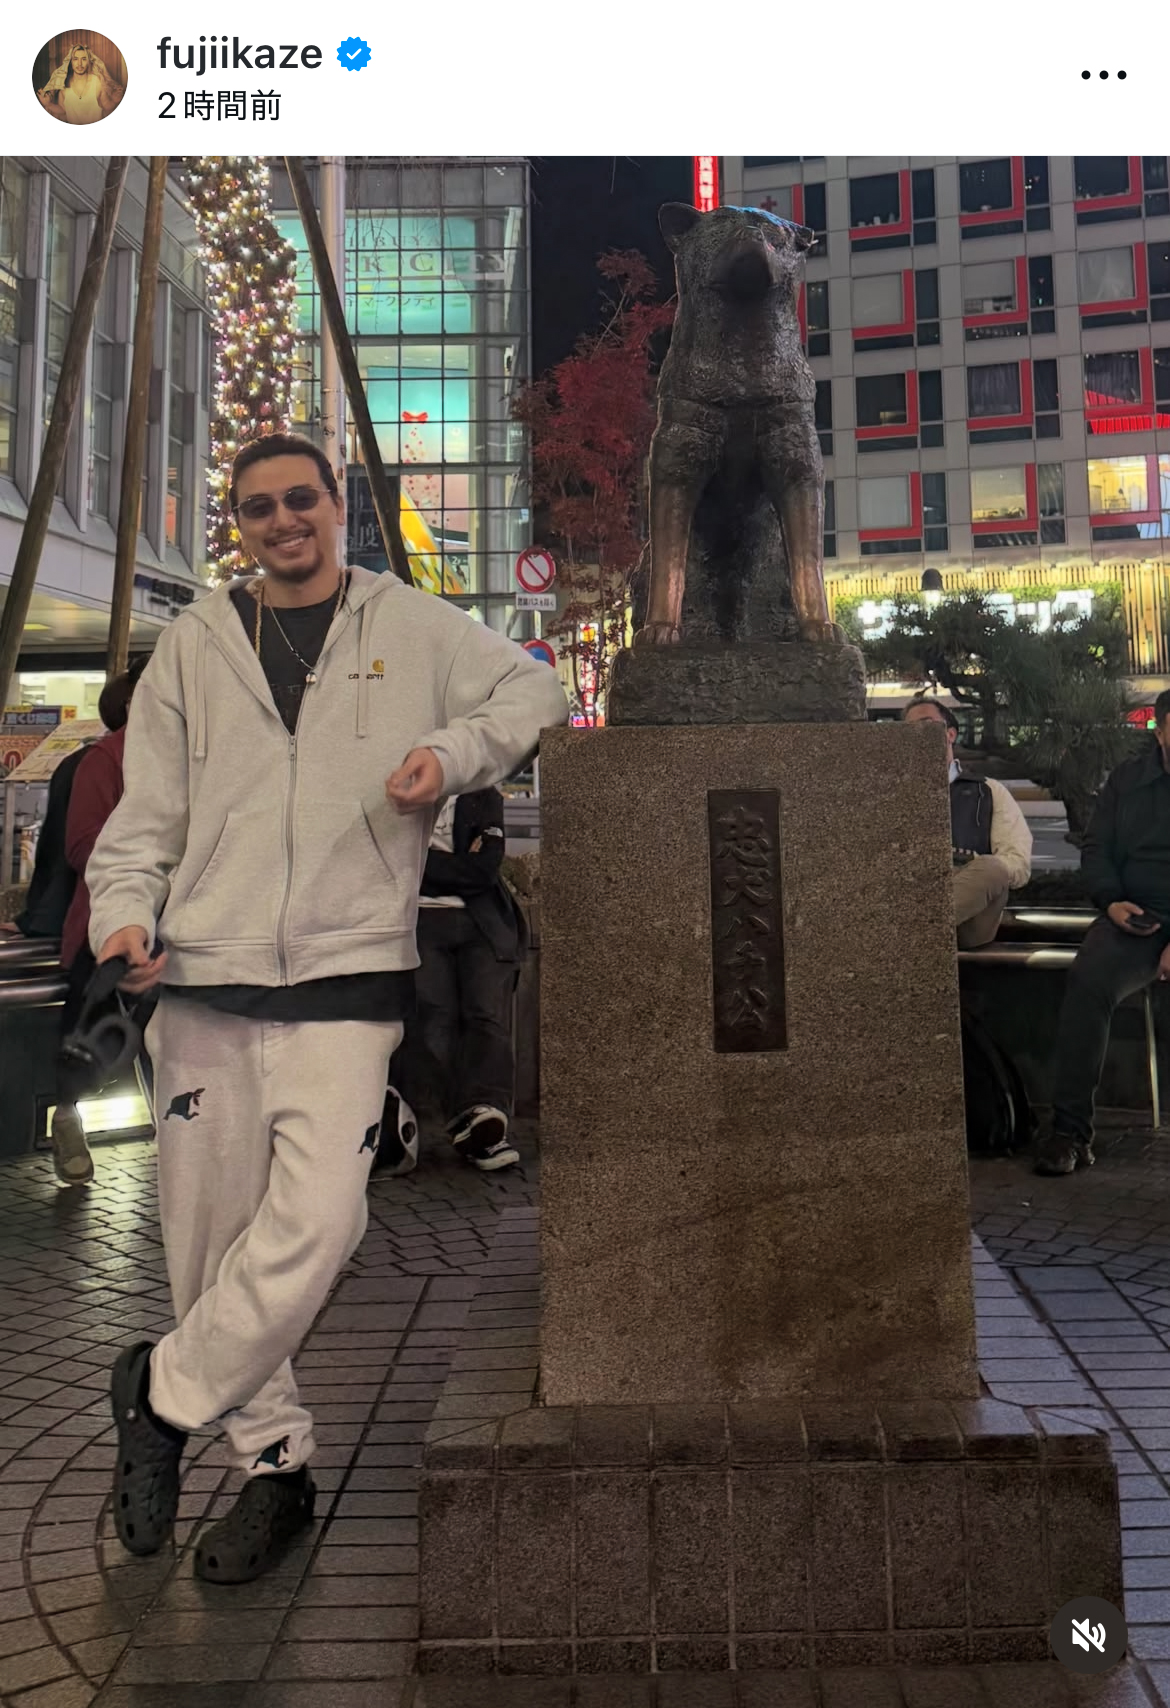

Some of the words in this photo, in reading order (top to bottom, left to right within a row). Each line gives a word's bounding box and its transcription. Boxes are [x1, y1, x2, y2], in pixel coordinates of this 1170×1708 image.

[715, 805, 775, 1033] 忠犬ハチ公
